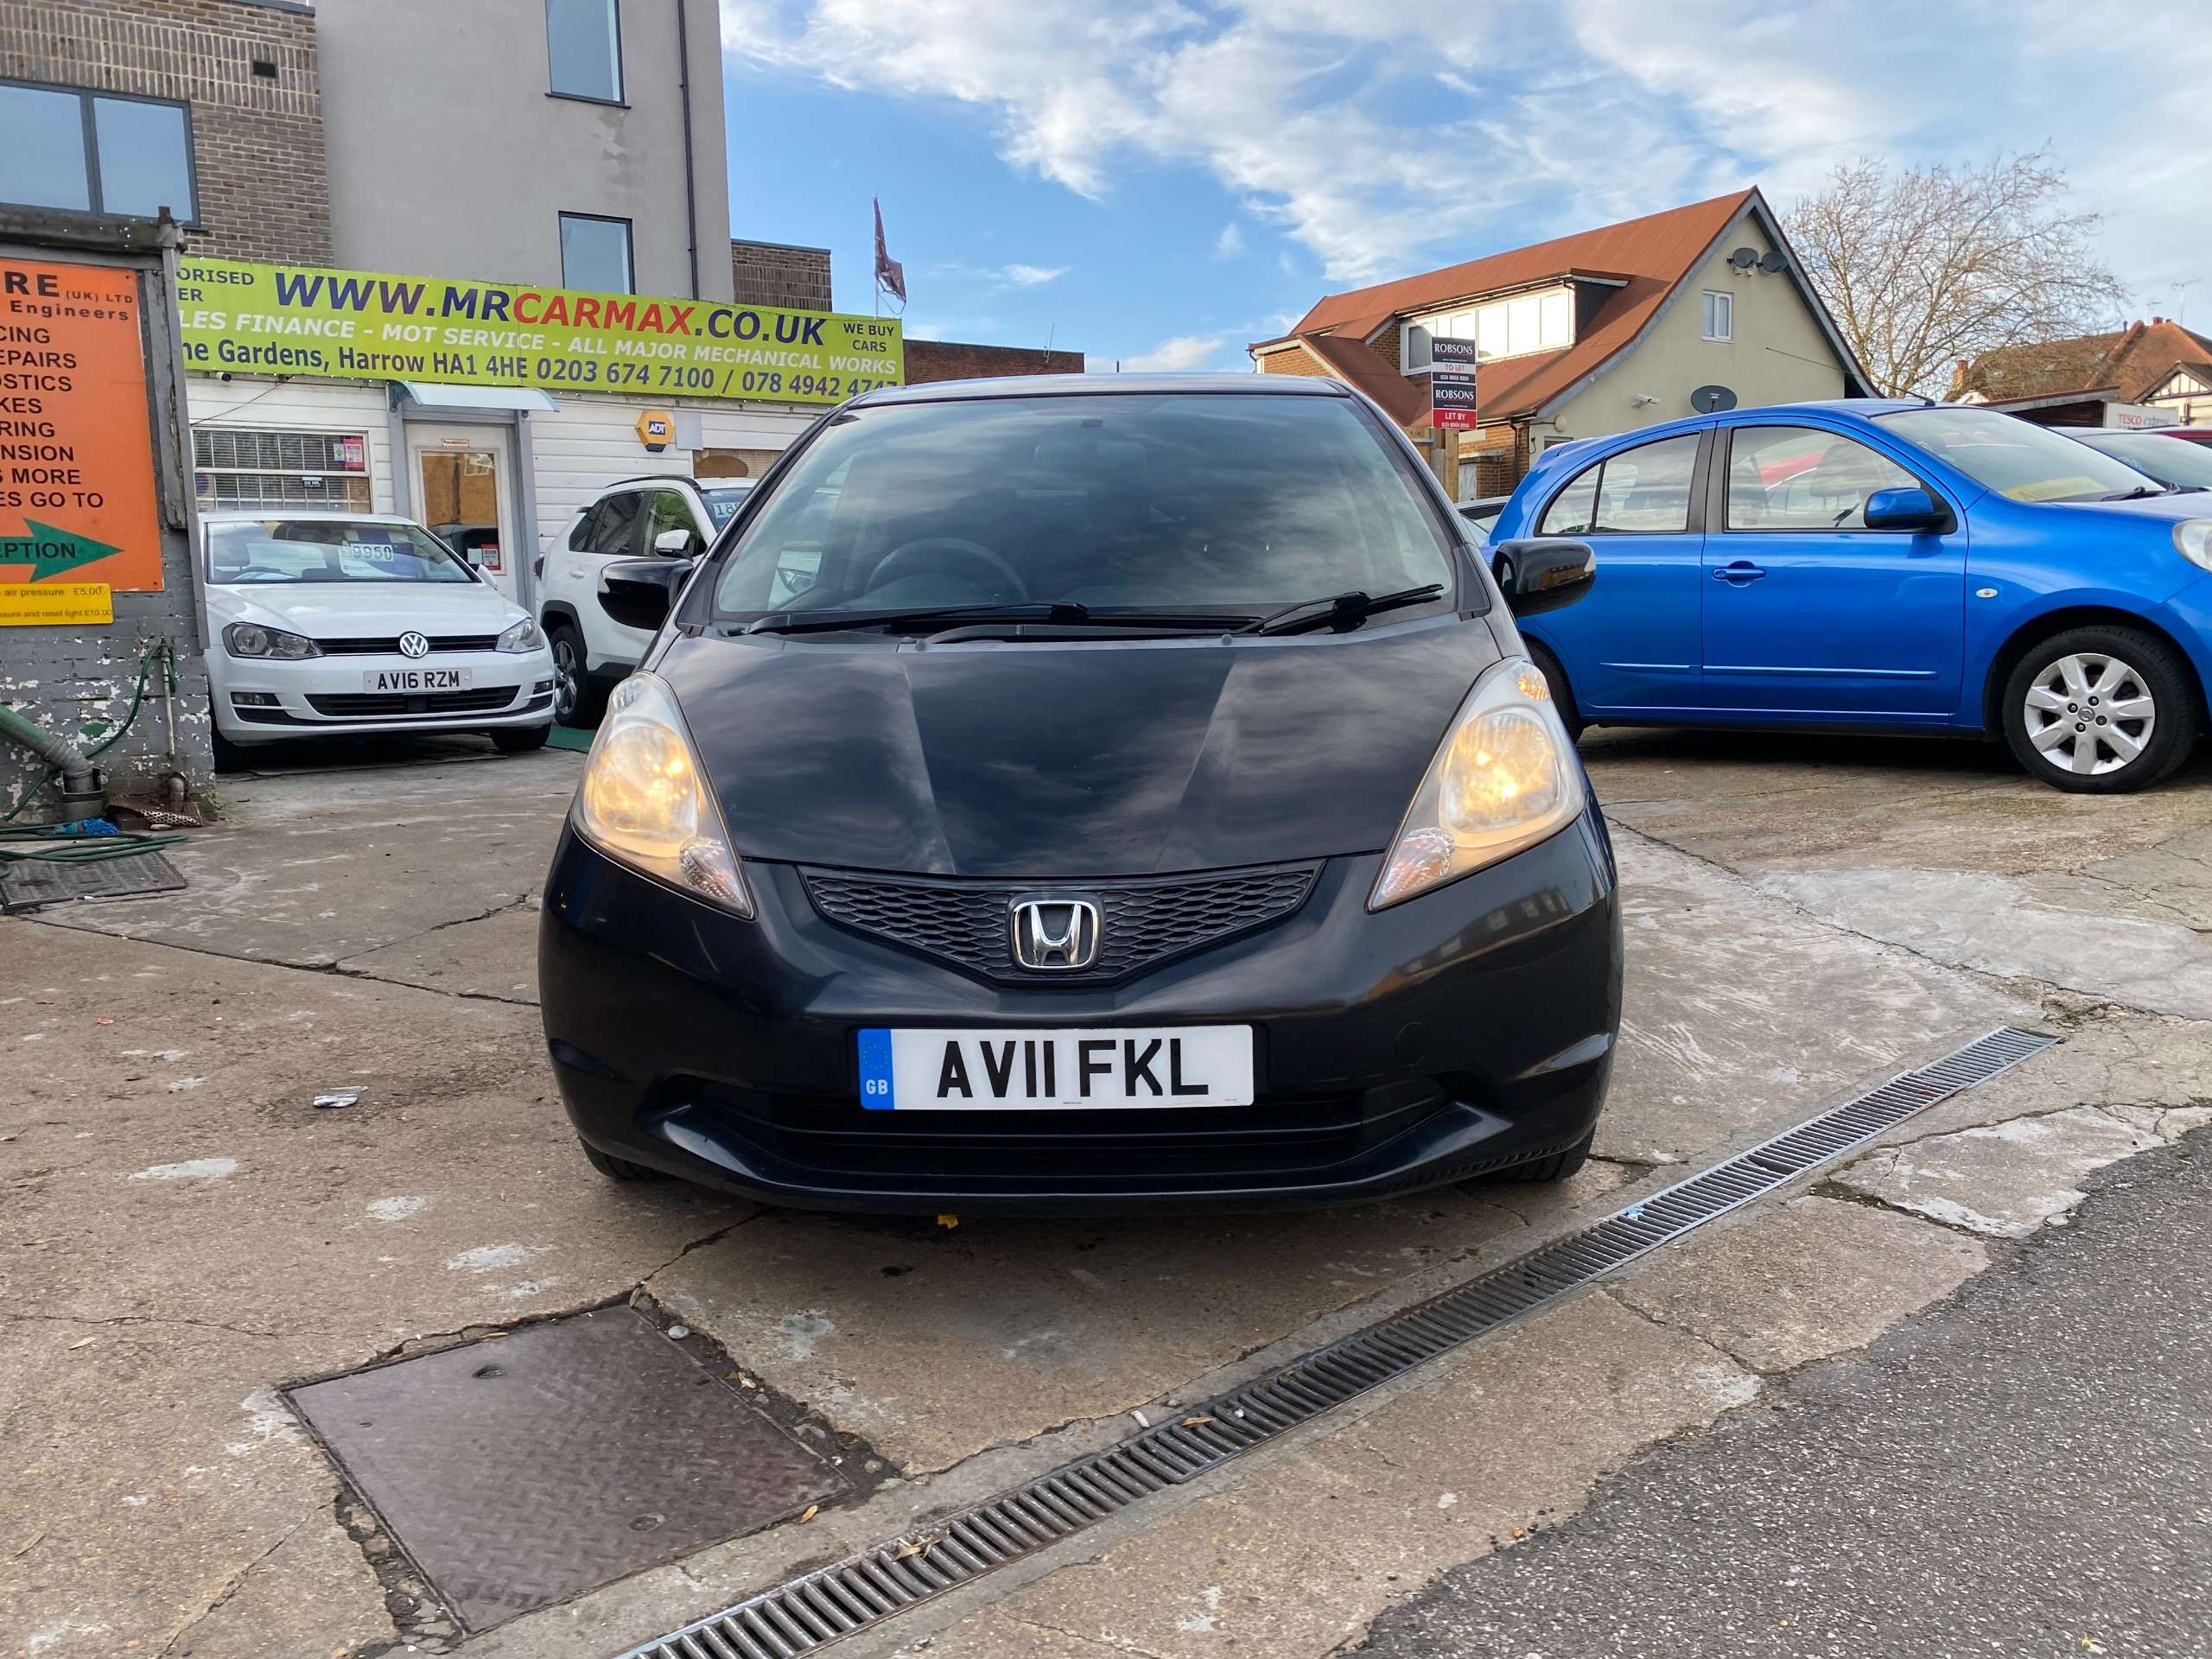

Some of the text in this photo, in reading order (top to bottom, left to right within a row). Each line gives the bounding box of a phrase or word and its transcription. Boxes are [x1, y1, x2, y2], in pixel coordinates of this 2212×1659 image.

[177, 267, 255, 285] ORISED
[3, 271, 133, 303] RE (UK) LTD
[178, 288, 203, 302] ER
[10, 300, 129, 321] Engineers
[275, 272, 828, 346] WWW.MRCARMAX.CO.UK
[843, 322, 894, 337] WE BUY
[179, 309, 226, 330] LES
[236, 314, 356, 339] FINANCE
[382, 323, 437, 343] MOT
[443, 326, 546, 351] SERVICE
[568, 336, 607, 355] ALL
[614, 340, 687, 360] MAJOR
[694, 345, 823, 370] MECHANICAL
[830, 355, 897, 374] WORKS
[852, 340, 887, 353] CARS
[1434, 343, 1473, 355] ROBSONS
[218, 339, 330, 372] Gardens,
[339, 346, 424, 372] Harrow
[433, 353, 478, 376] HA1
[486, 355, 528, 378] 4HE
[537, 358, 598, 382] 0203
[607, 362, 650, 385] 674
[658, 365, 715, 389] 7100
[742, 371, 782, 393] 078
[789, 375, 841, 397] 4942
[847, 378, 898, 397] 47
[0, 373, 73, 391] STICS
[1435, 389, 1474, 400] ROBSONS
[1457, 412, 1466, 421] BY
[2118, 415, 2143, 425] TESCO
[0, 421, 55, 438] RING
[649, 423, 666, 434] ADT
[0, 444, 74, 461] NSION
[11, 468, 81, 485] MORE
[30, 492, 66, 508] GO
[73, 493, 104, 508] TO
[0, 542, 76, 559] PTION
[4, 587, 102, 598] air pressure £5.00
[24, 609, 40, 618] and
[41, 608, 63, 617] reset
[65, 607, 83, 619] light
[377, 671, 460, 690] AV16 RZM
[936, 1038, 1210, 1098] AV11 FKL
[866, 1078, 888, 1096] GB
